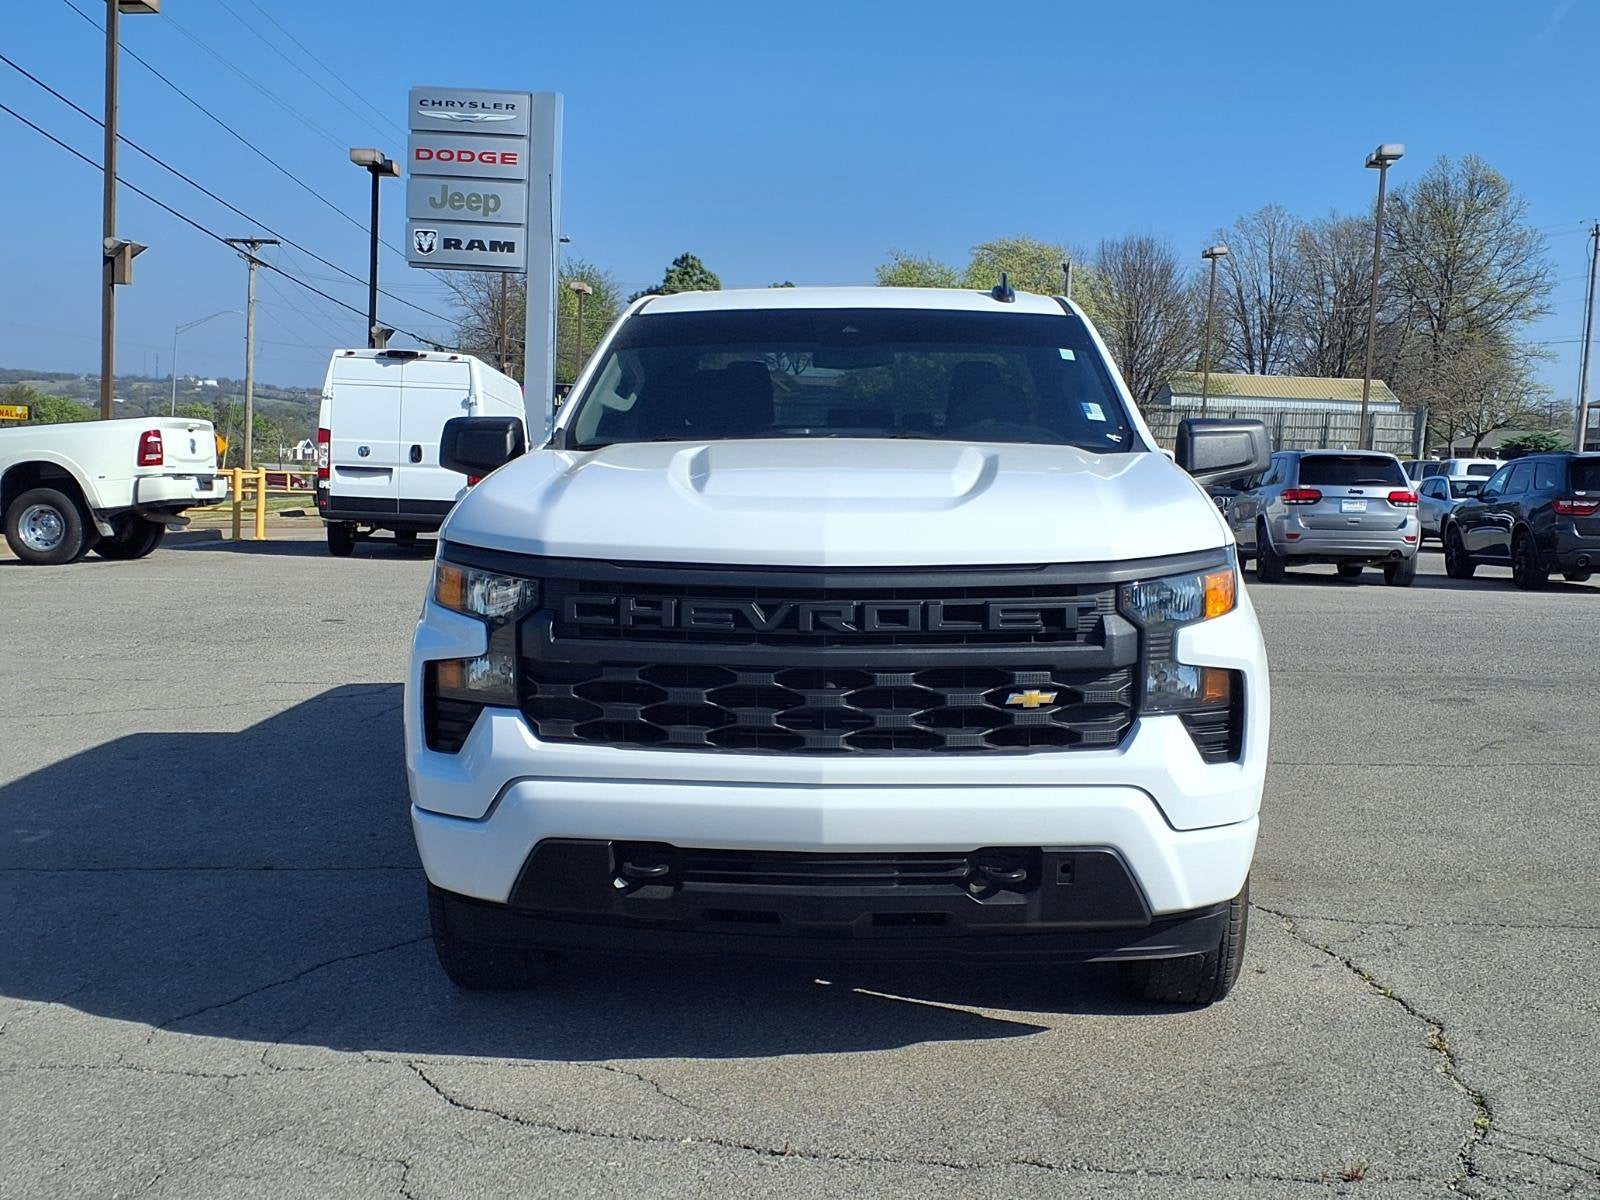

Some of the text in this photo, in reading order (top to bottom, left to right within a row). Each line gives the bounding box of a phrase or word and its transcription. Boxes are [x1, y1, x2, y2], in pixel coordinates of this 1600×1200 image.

[419, 99, 516, 111] CHRYSLER
[415, 148, 518, 165] DODGE
[429, 184, 502, 217] Jeep
[443, 237, 515, 253] RAM
[565, 597, 1097, 631] CHEVROLET
